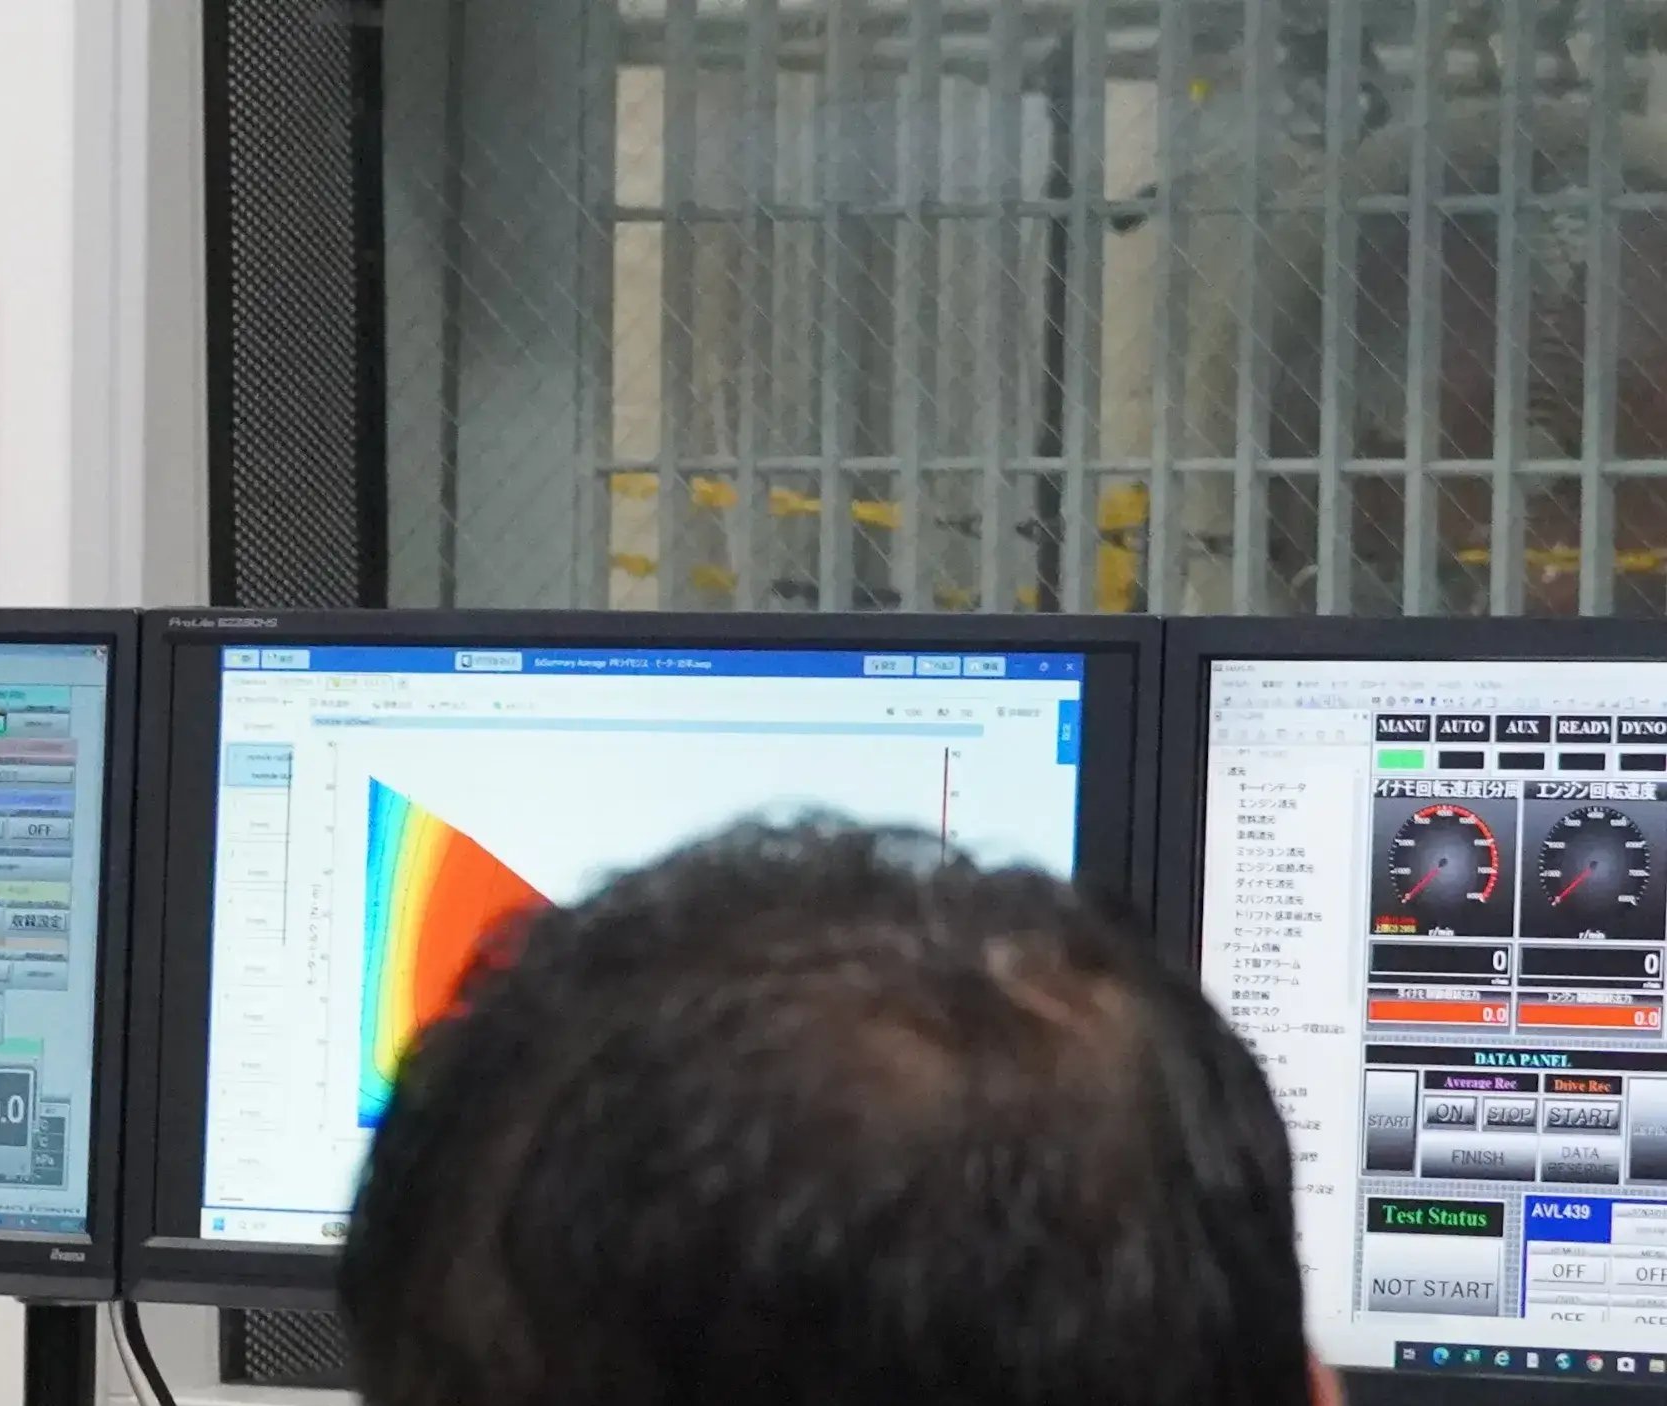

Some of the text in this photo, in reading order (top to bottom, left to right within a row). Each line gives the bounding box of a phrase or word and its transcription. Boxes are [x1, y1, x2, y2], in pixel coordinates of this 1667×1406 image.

[1379, 719, 1427, 733] MANU
[1440, 719, 1485, 733] AUTO
[1505, 720, 1540, 734] AUX
[1558, 721, 1610, 735] READY
[1621, 721, 1667, 735] DYNO
[1373, 780, 1518, 799] イナモ回転速度[分周
[1536, 782, 1657, 800] エンジン回転速度
[27, 823, 52, 837] OFF
[1492, 950, 1507, 971] 0
[1644, 953, 1659, 974] 0
[1482, 1007, 1507, 1022] 0.0
[1633, 1011, 1658, 1026] 0.0
[1474, 1051, 1572, 1068] DATA PANEL
[1444, 1076, 1517, 1090] Average Rec
[1554, 1079, 1611, 1092] Drive Rec
[1436, 1103, 1464, 1122] ON
[1487, 1106, 1532, 1121] STOP
[1550, 1107, 1615, 1128] START
[1368, 1115, 1411, 1129] START
[1451, 1149, 1505, 1166] FINISH
[1561, 1146, 1600, 1159] DATA
[1382, 1204, 1488, 1228] Test Status
[1532, 1205, 1591, 1220] AVL439
[1552, 1263, 1587, 1279] OFF
[1372, 1278, 1495, 1300] NOT START
